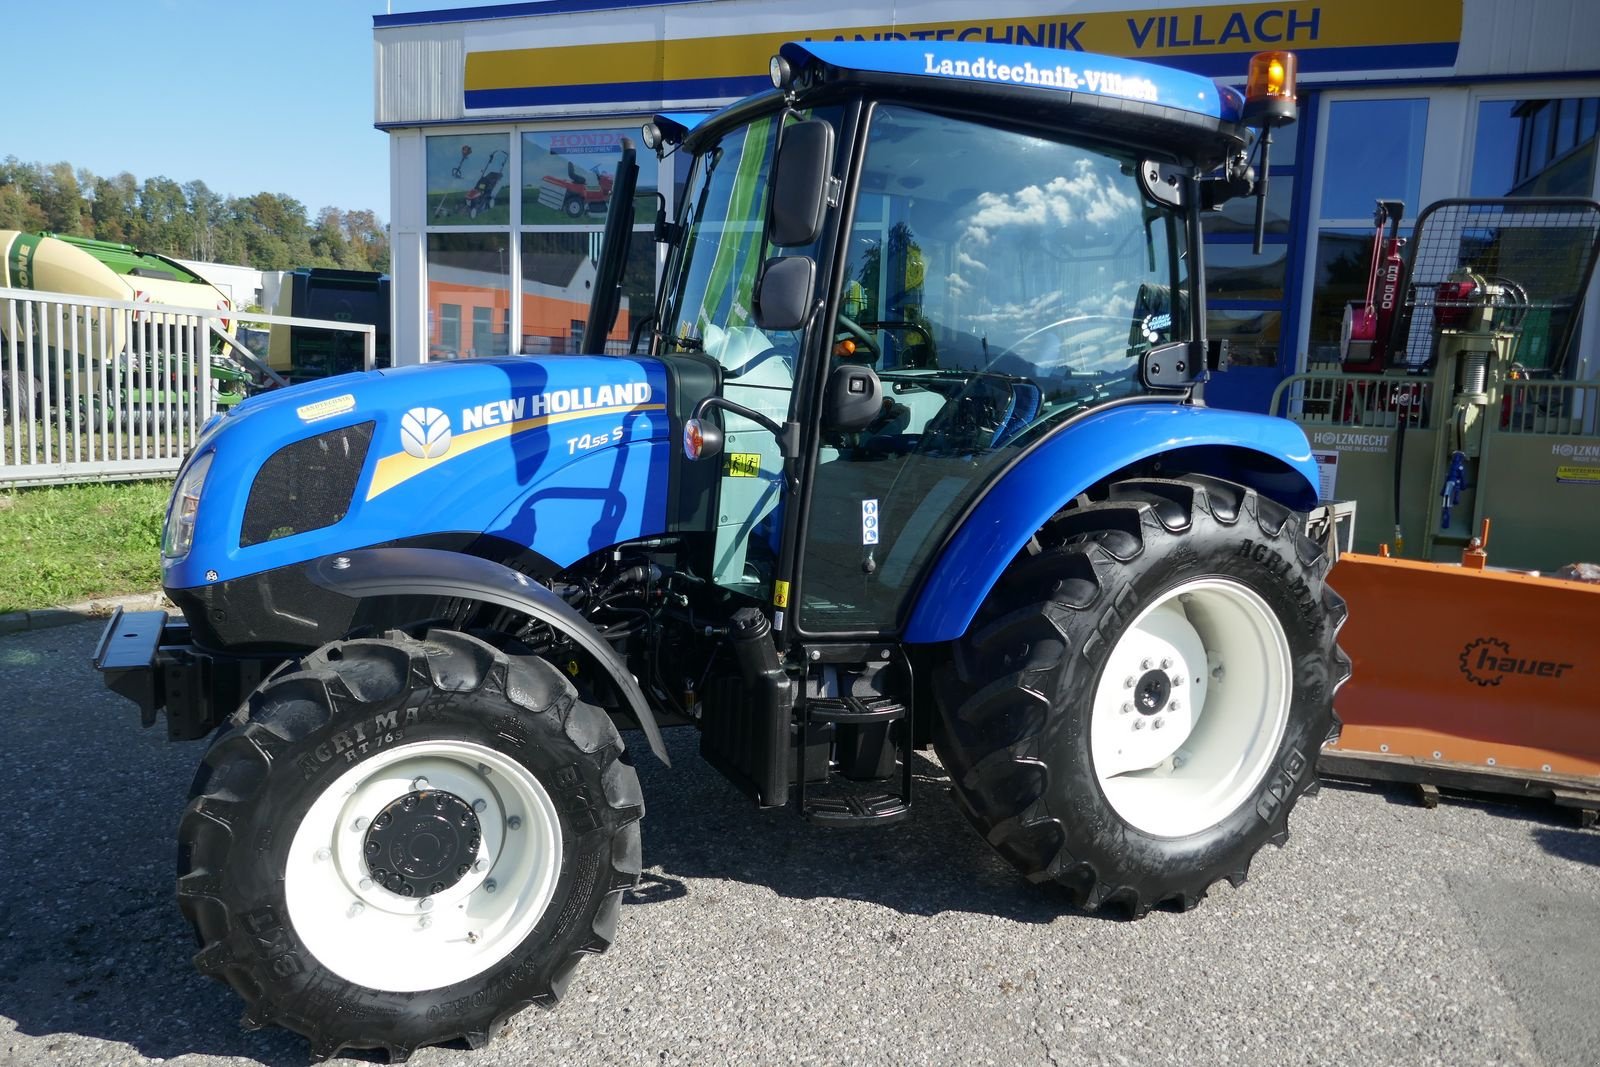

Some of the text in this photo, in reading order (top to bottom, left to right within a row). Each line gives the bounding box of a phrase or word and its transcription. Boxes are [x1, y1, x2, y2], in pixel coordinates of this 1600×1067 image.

[1127, 8, 1320, 49] VILLACH
[1381, 284, 1395, 309] 500
[463, 382, 652, 431] NEW HOLLAND
[1391, 393, 1421, 406] HOL
[612, 425, 624, 441] S
[1314, 432, 1390, 446] HOLZKNECHT
[1552, 444, 1600, 456] HOLZKN
[1477, 648, 1574, 678] hauer
[344, 742, 369, 763] RT
[1256, 747, 1307, 826] BKT
